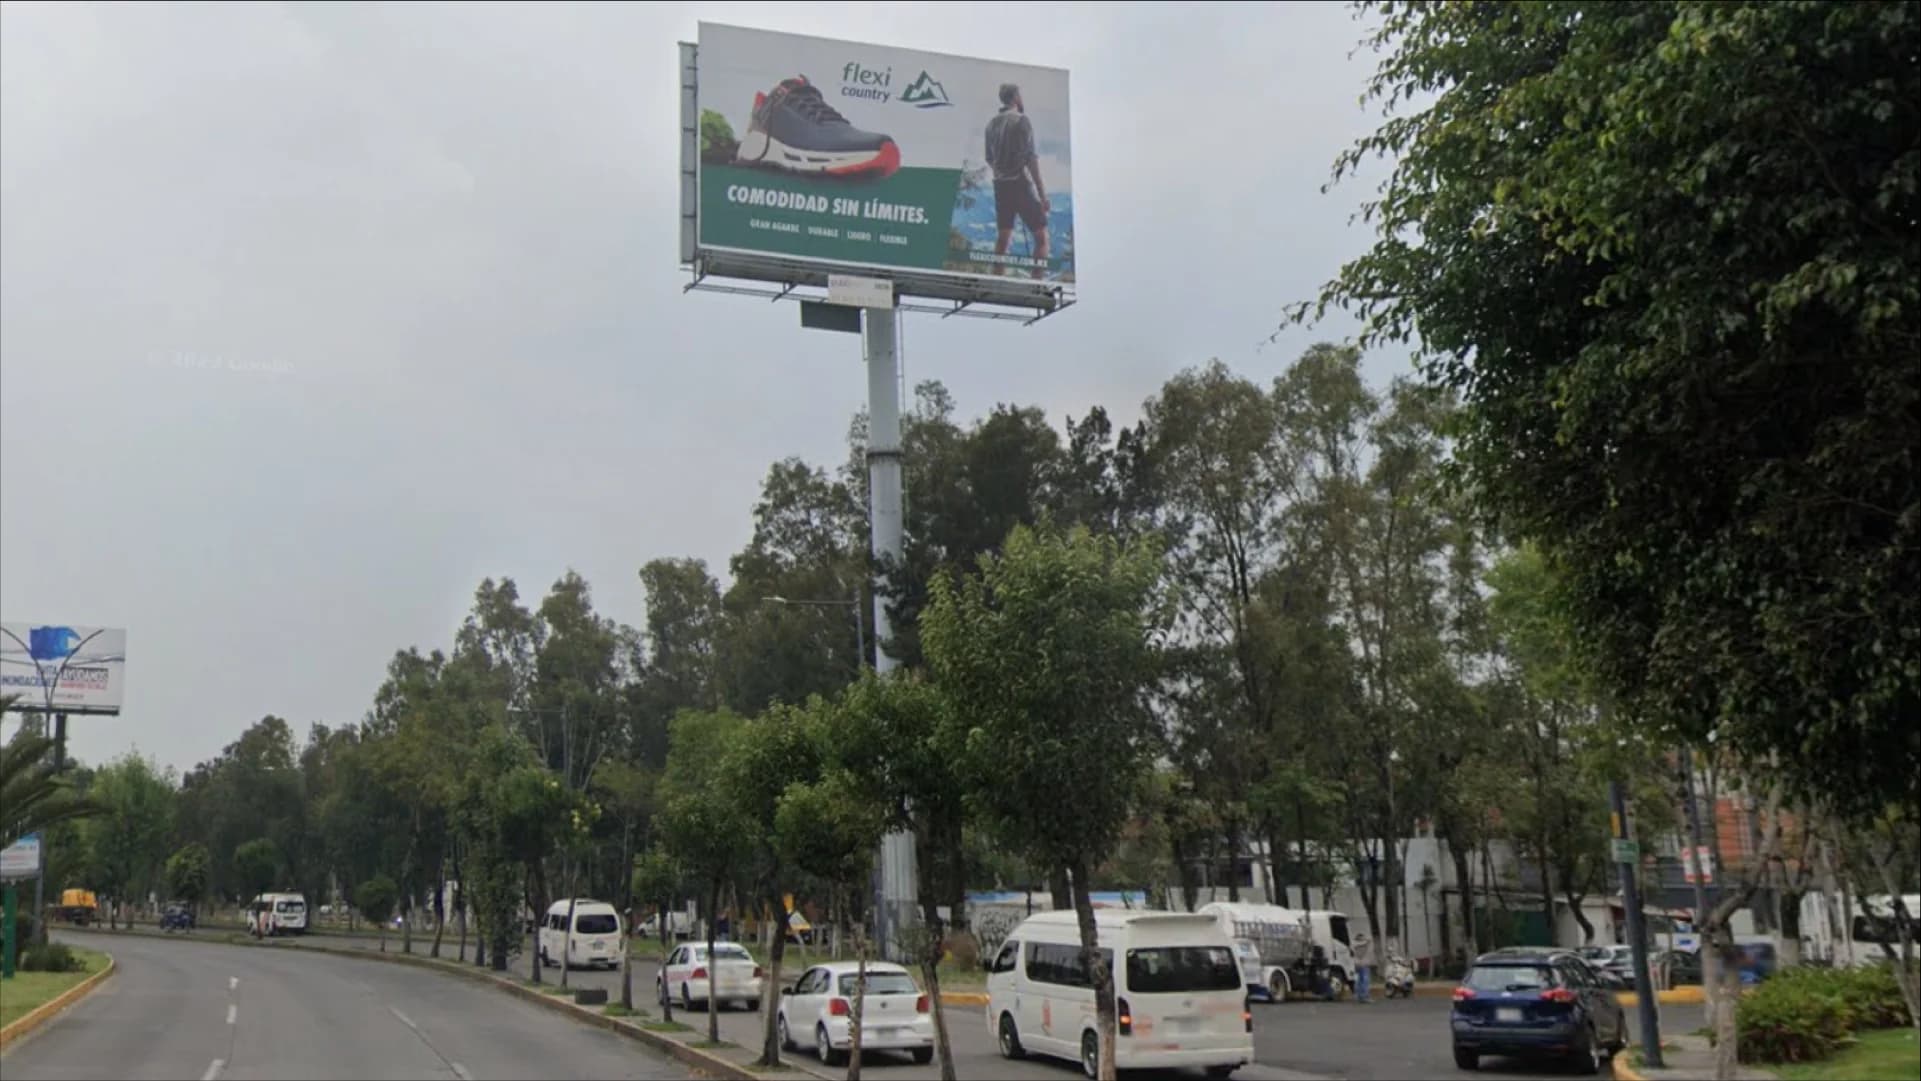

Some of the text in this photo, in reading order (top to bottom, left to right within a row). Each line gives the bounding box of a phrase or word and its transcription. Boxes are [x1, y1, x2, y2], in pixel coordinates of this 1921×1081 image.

[843, 62, 892, 88] flexi
[841, 86, 891, 104] country
[727, 184, 929, 225] COMODIDAD SIN LÍMITES.
[807, 226, 839, 238] DURABLE
